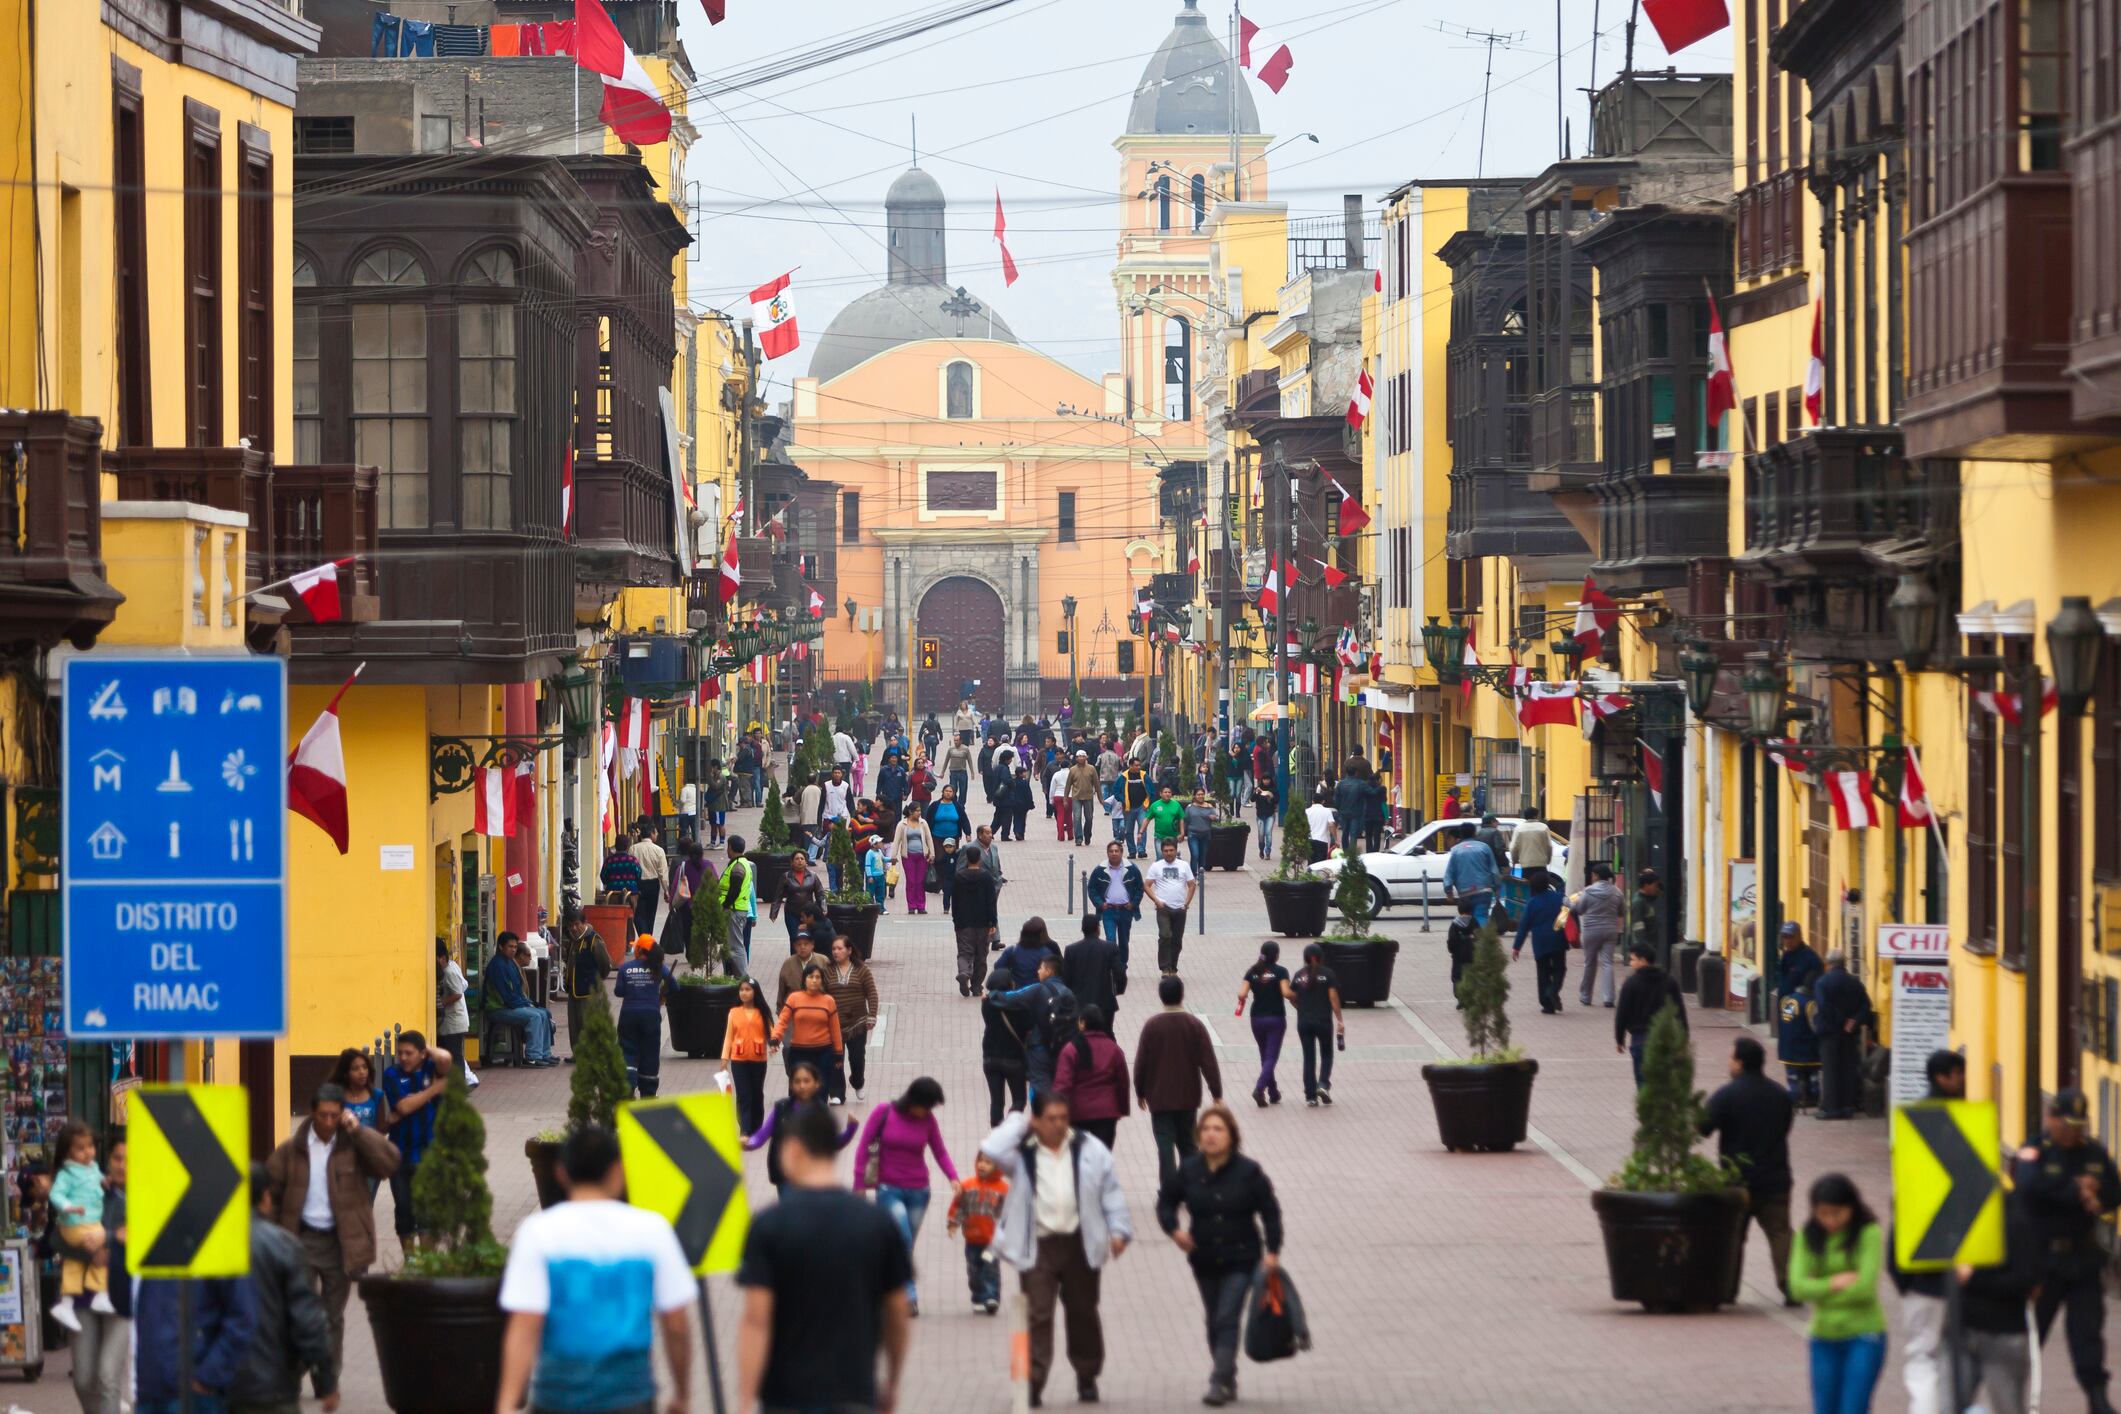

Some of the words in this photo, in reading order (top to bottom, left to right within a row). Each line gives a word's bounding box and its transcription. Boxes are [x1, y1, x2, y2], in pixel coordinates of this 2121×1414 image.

[116, 902, 238, 931] DISTRITO
[150, 942, 203, 971] DEL
[133, 982, 220, 1011] RIMAC
